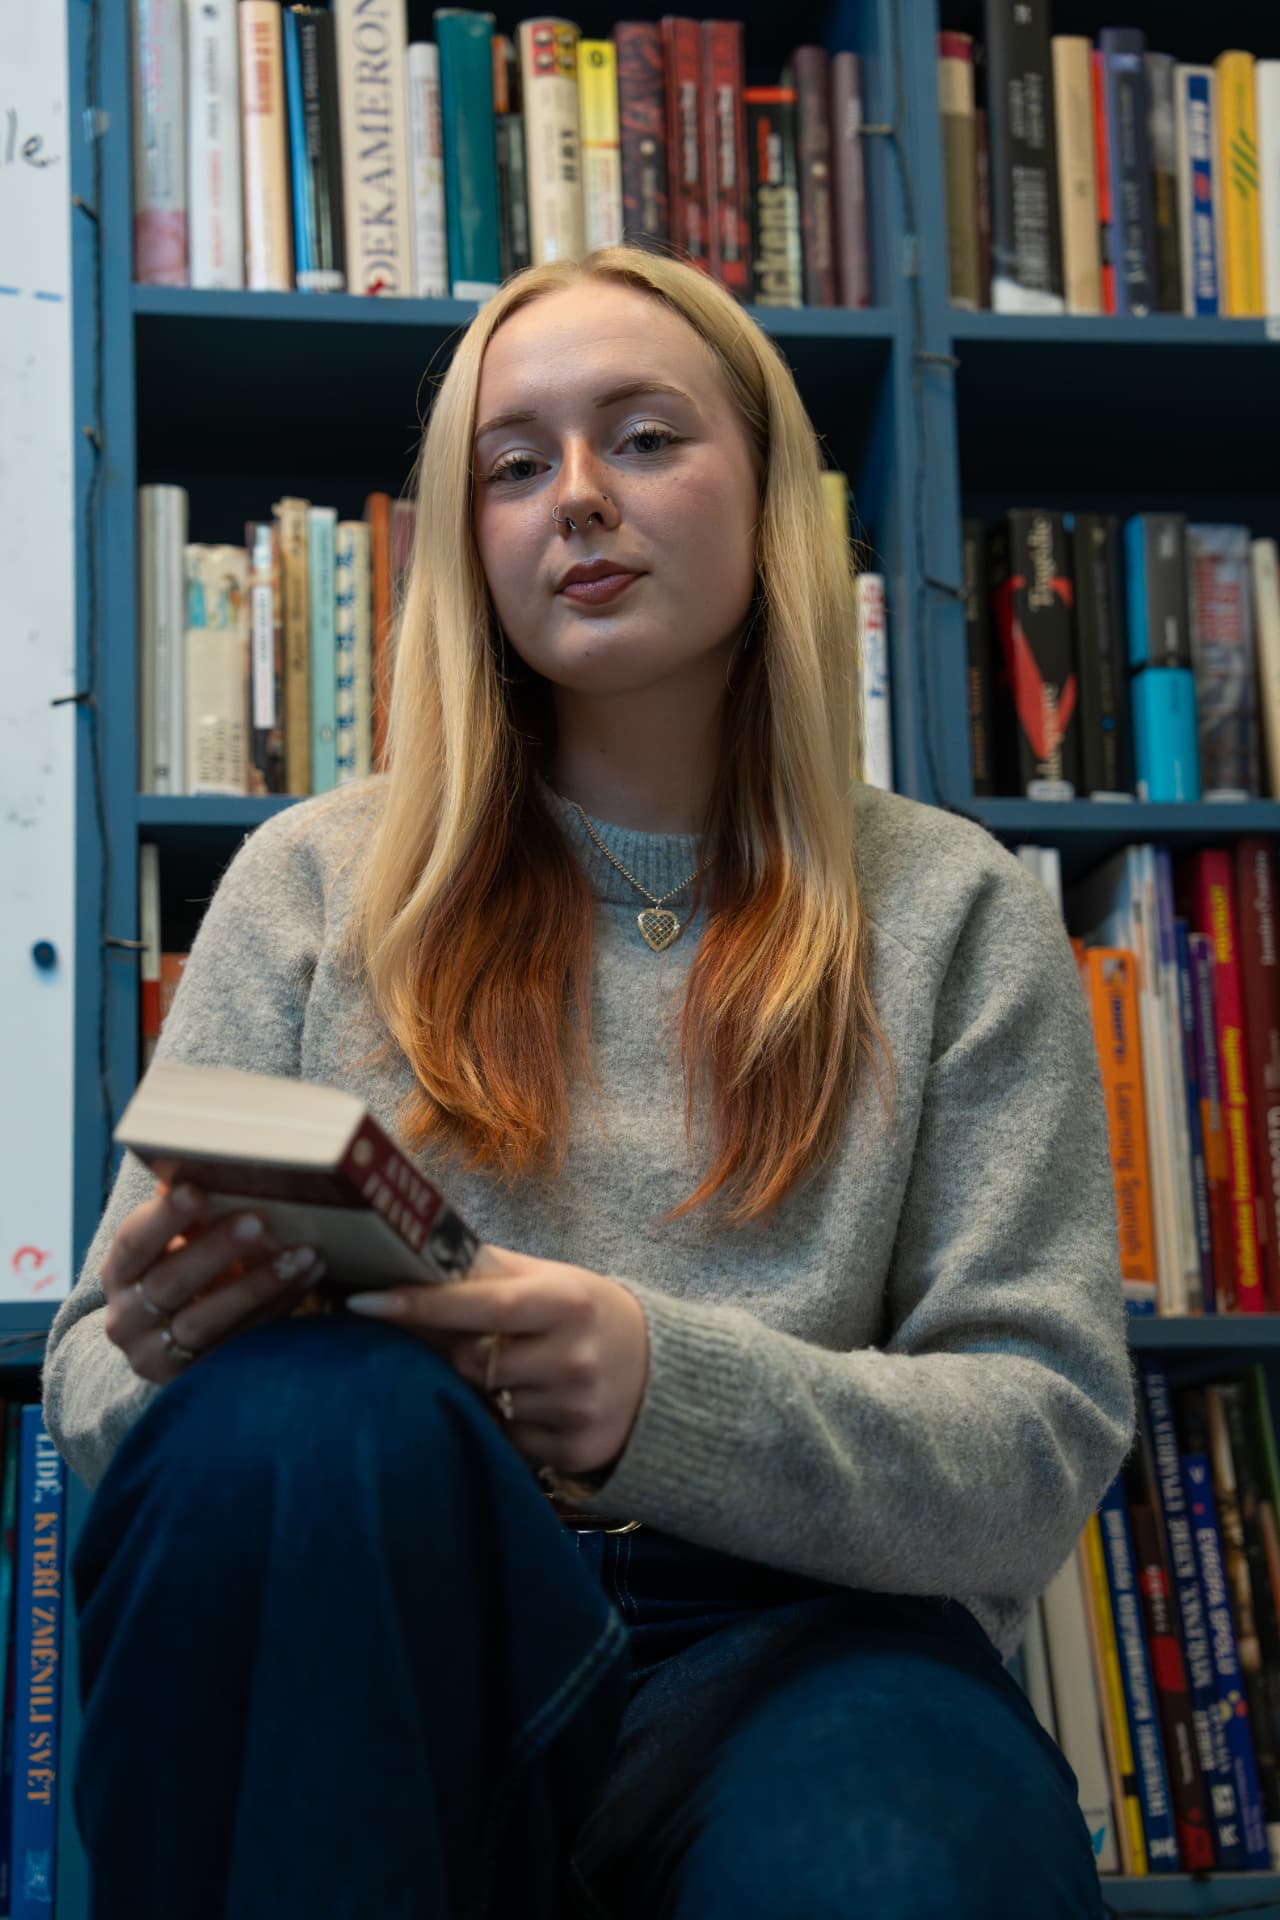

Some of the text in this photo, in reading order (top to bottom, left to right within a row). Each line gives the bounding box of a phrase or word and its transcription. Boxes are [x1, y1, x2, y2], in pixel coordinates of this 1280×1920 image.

[353, 0, 398, 294] DEKAMERON
[754, 186, 801, 308] ickens
[1114, 1080, 1137, 1173] Learning
[33, 1512, 60, 1599] KTEŘÍ
[1198, 1528, 1236, 1675] EVROPA SPOLU
[29, 1607, 58, 1723] ZMĚNILI
[27, 1731, 56, 1805] SVĚT
